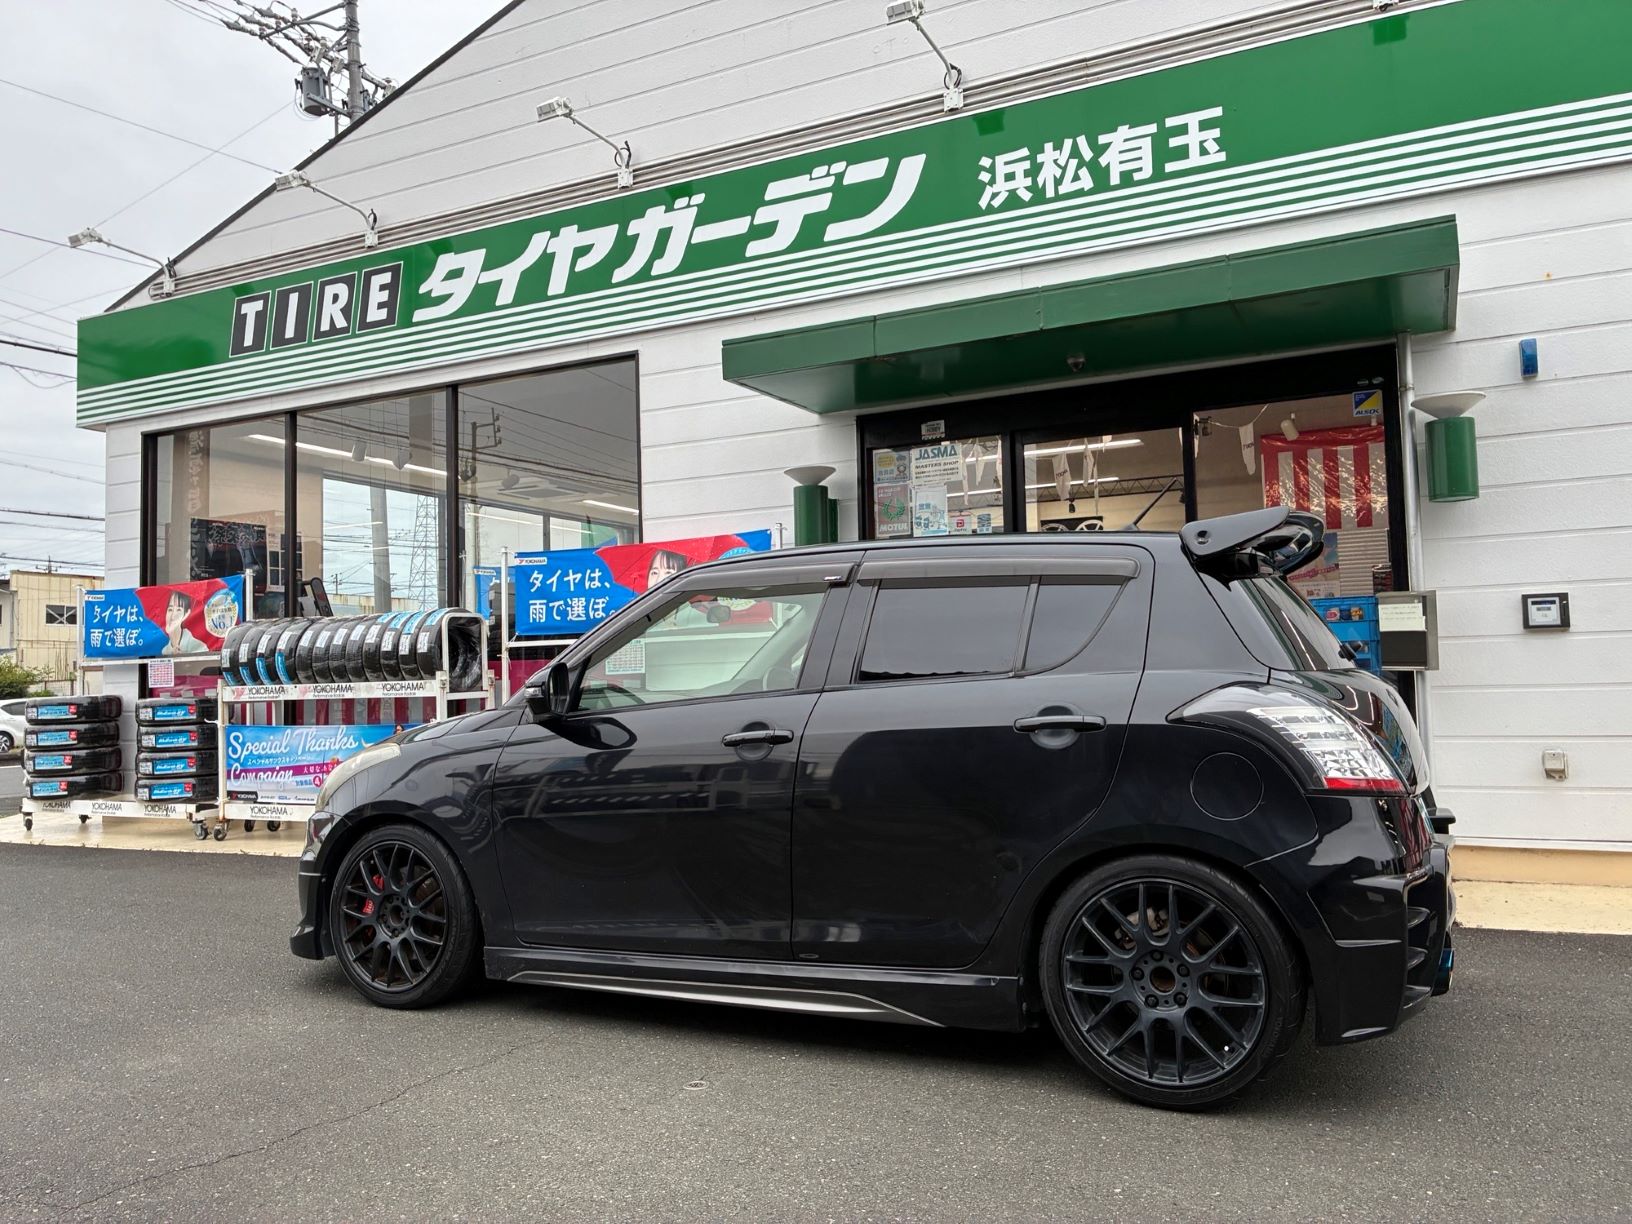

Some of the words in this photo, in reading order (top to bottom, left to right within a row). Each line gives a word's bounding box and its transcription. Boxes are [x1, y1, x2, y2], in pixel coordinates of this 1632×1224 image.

[978, 106, 1226, 210] 浜松有玉
[412, 154, 926, 323] タイヤガーデン
[239, 268, 395, 351] TIRE
[915, 445, 957, 460] JASMA
[879, 522, 908, 532] MOTUL
[529, 568, 611, 593] タイヤは、
[92, 604, 144, 624] タイヤは、
[249, 686, 286, 696] YOKOHAMA
[312, 683, 352, 693] YOKOHAMA
[381, 682, 424, 692] YOKOHAMA
[228, 728, 290, 763] Special
[293, 725, 359, 755] Thanks
[230, 763, 294, 791] Campaign
[91, 802, 122, 812] YOKOHAMA
[144, 804, 177, 814] YOKOHAMA
[250, 805, 288, 816] YOKOHAMA
